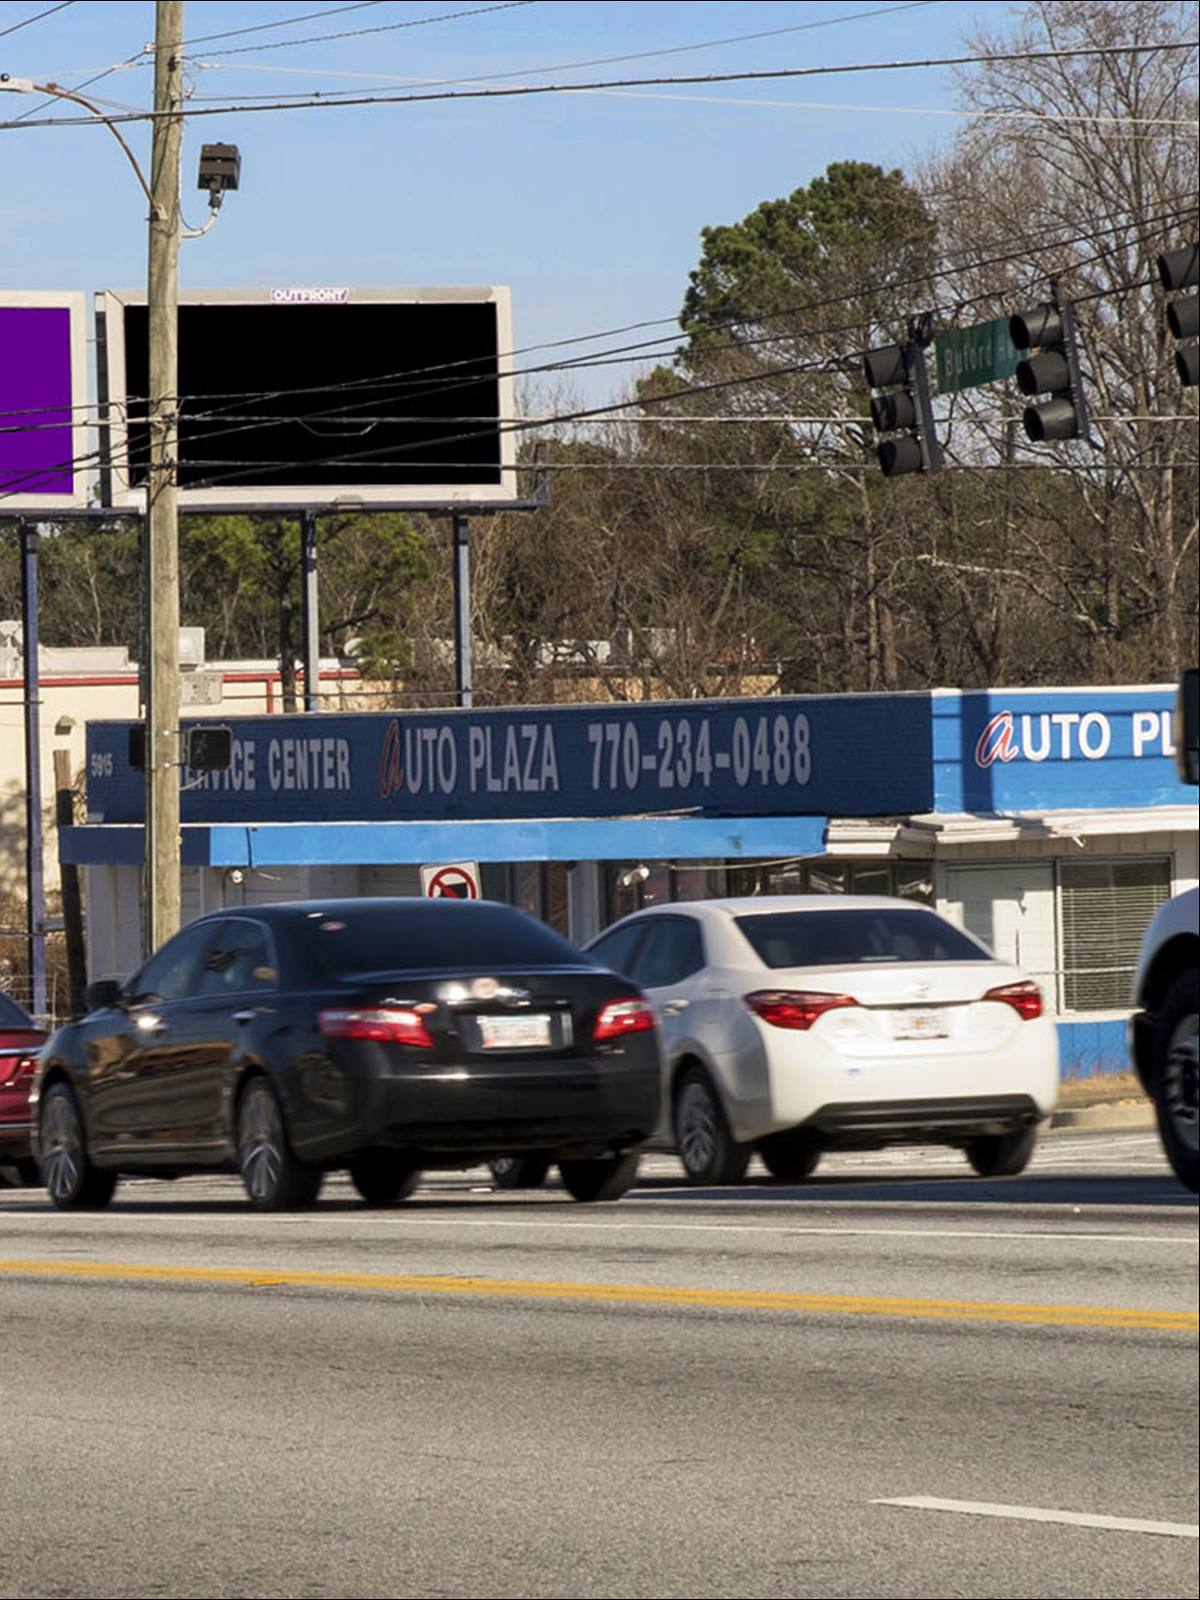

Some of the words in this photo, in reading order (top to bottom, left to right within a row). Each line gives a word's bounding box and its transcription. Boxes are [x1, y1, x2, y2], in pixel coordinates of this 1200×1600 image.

[272, 287, 348, 303] OUTFRONT
[267, 737, 350, 791] CENTER
[468, 723, 560, 793] PLAZA
[588, 713, 813, 791] 770-234-0488
